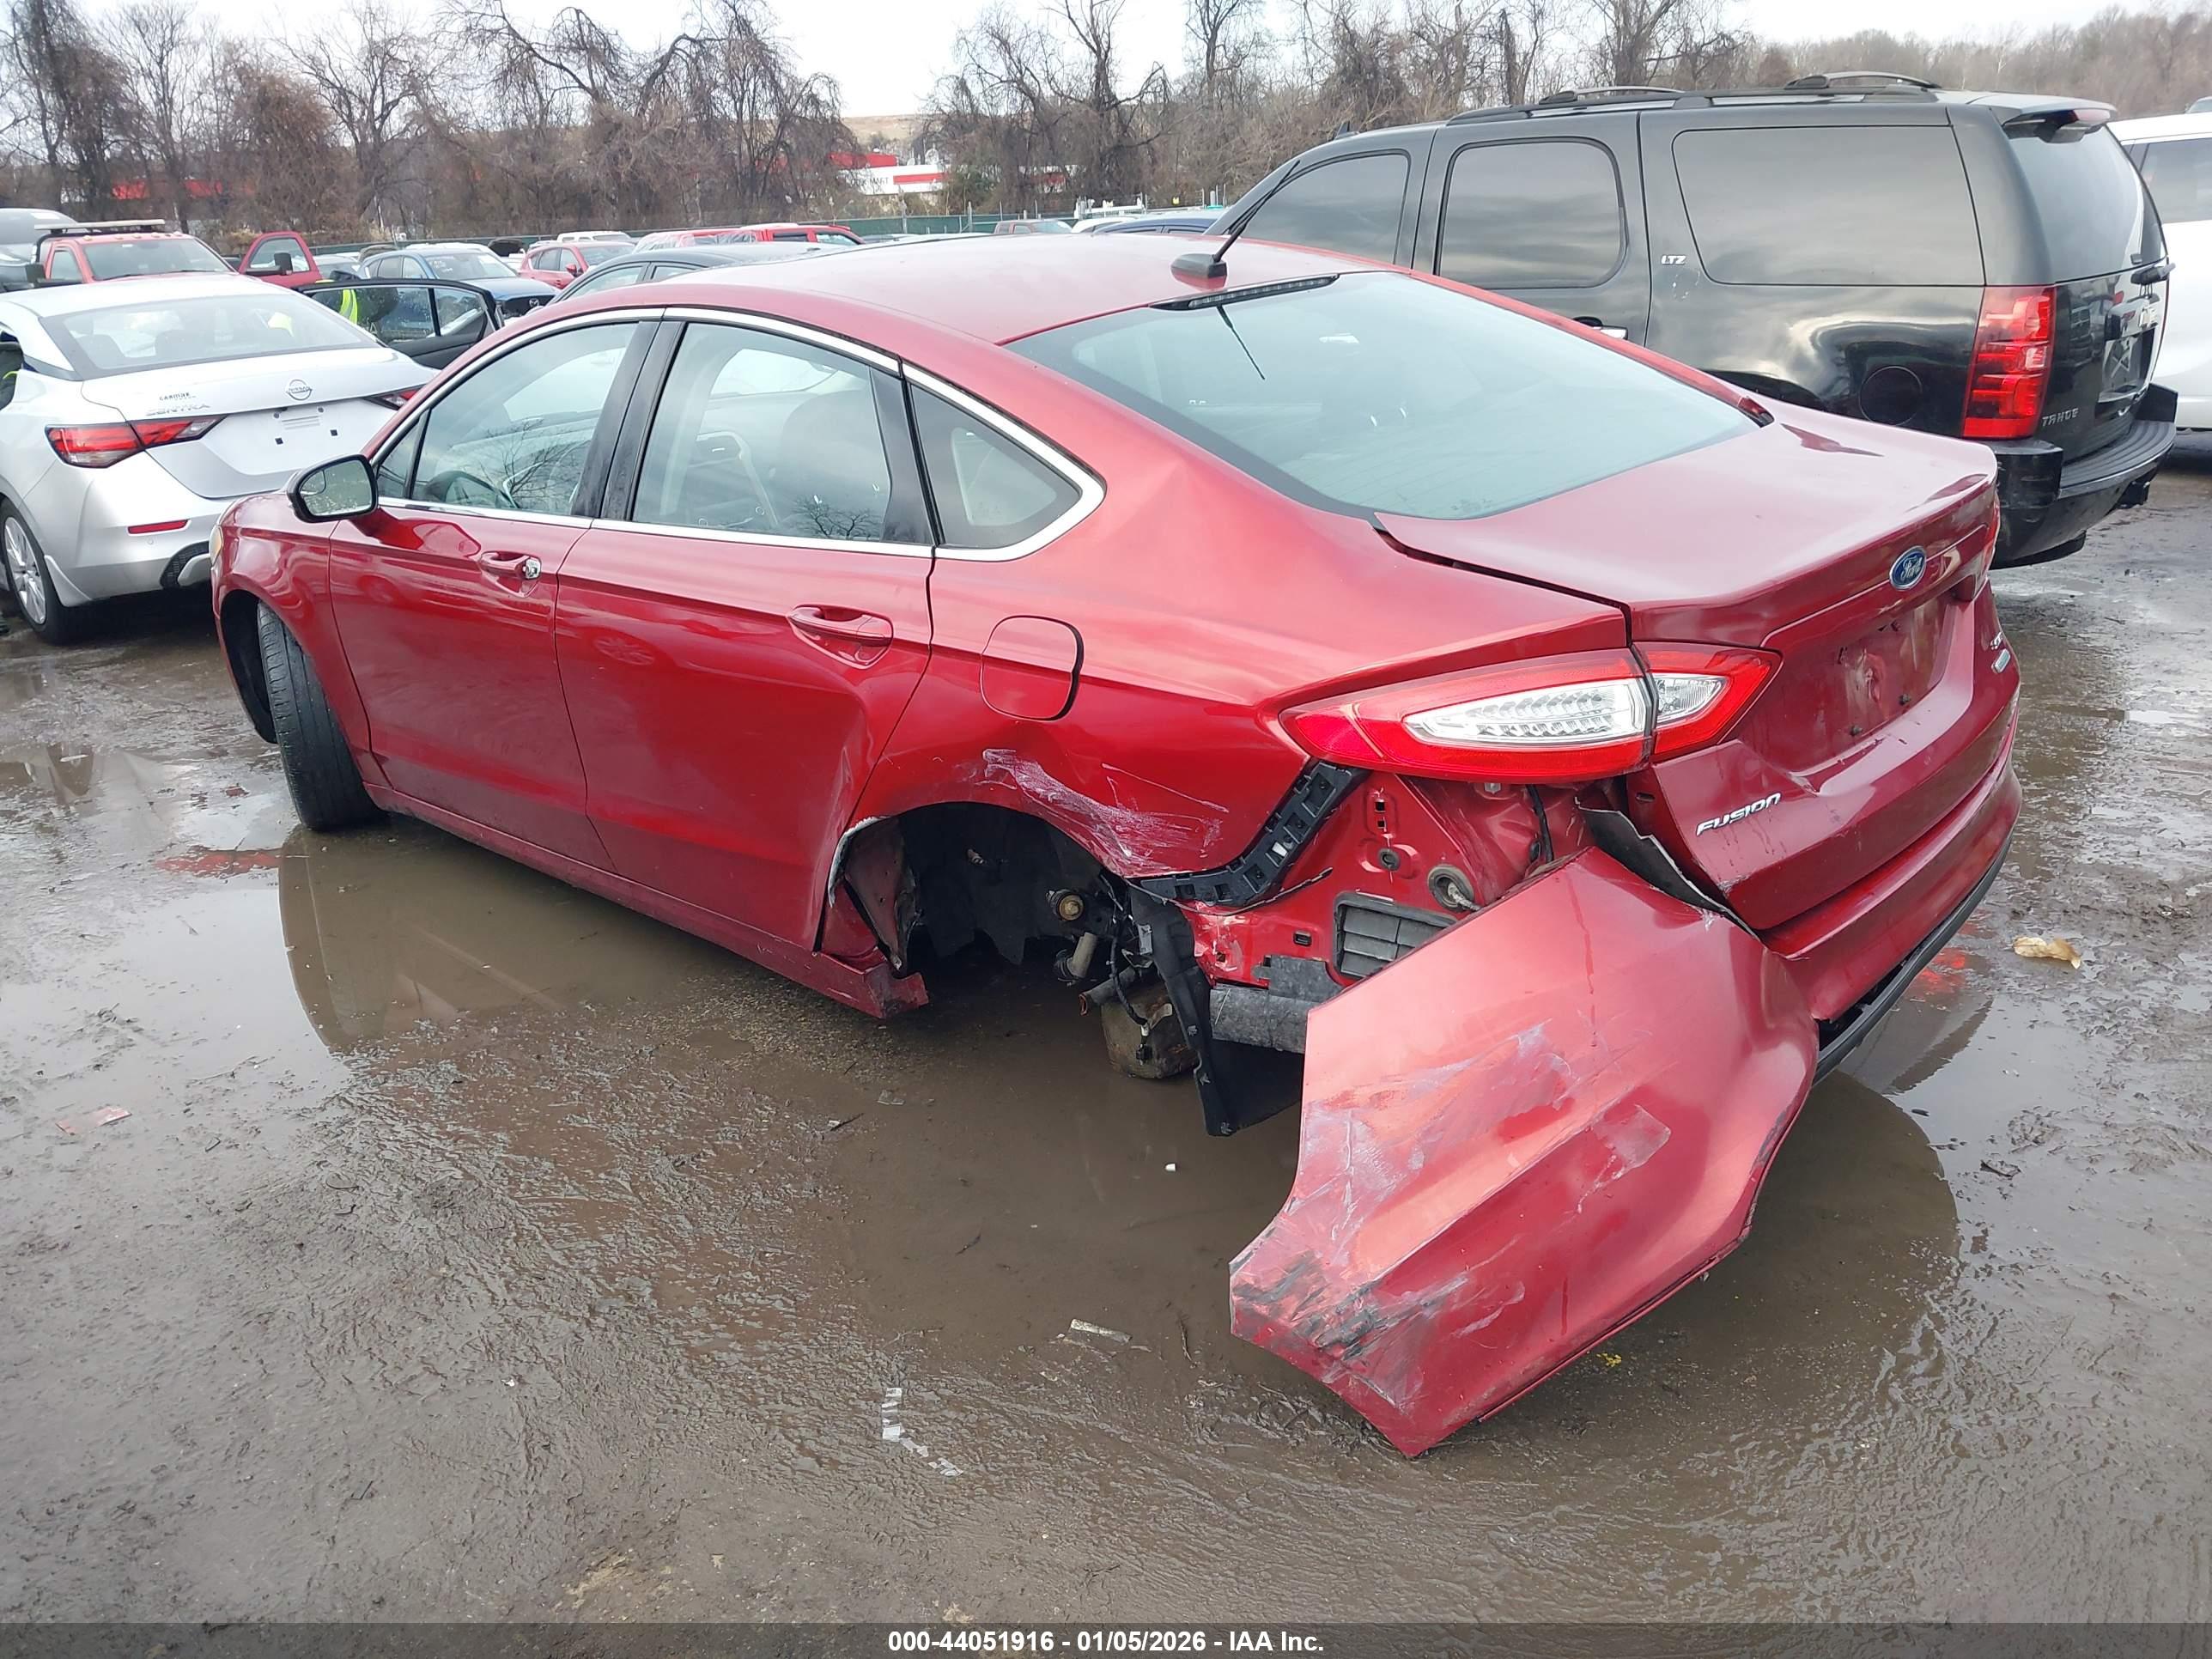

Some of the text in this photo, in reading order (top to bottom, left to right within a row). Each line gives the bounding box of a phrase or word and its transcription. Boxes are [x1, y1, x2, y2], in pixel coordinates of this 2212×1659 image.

[1661, 255, 1686, 264] LTZ
[2042, 407, 2079, 427] TAHOE
[1696, 792, 1781, 836] FUSION
